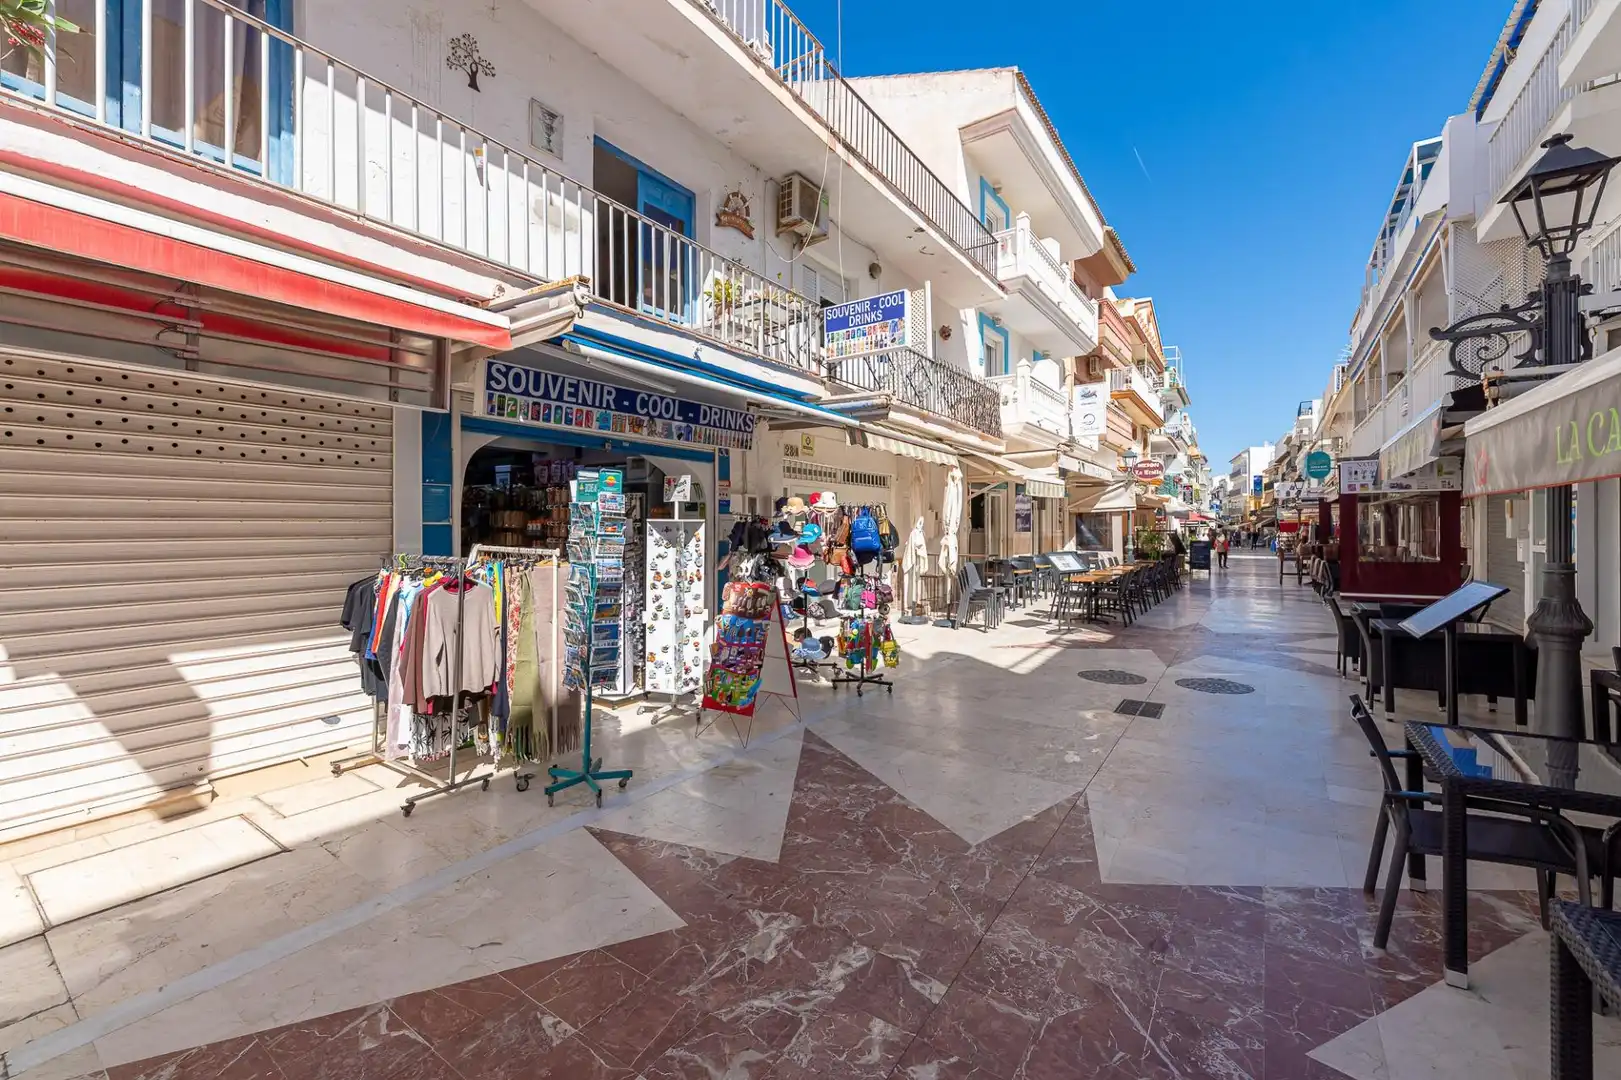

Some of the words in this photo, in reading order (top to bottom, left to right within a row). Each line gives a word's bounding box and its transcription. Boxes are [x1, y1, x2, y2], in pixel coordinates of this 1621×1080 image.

[826, 300, 871, 320] SOUVENIR
[879, 293, 904, 309] COOL
[848, 310, 883, 327] DRINKS
[489, 363, 617, 409] SOUVENIR
[636, 393, 683, 420] COOL
[699, 405, 754, 432] DRINKS
[1556, 421, 1583, 464] LA
